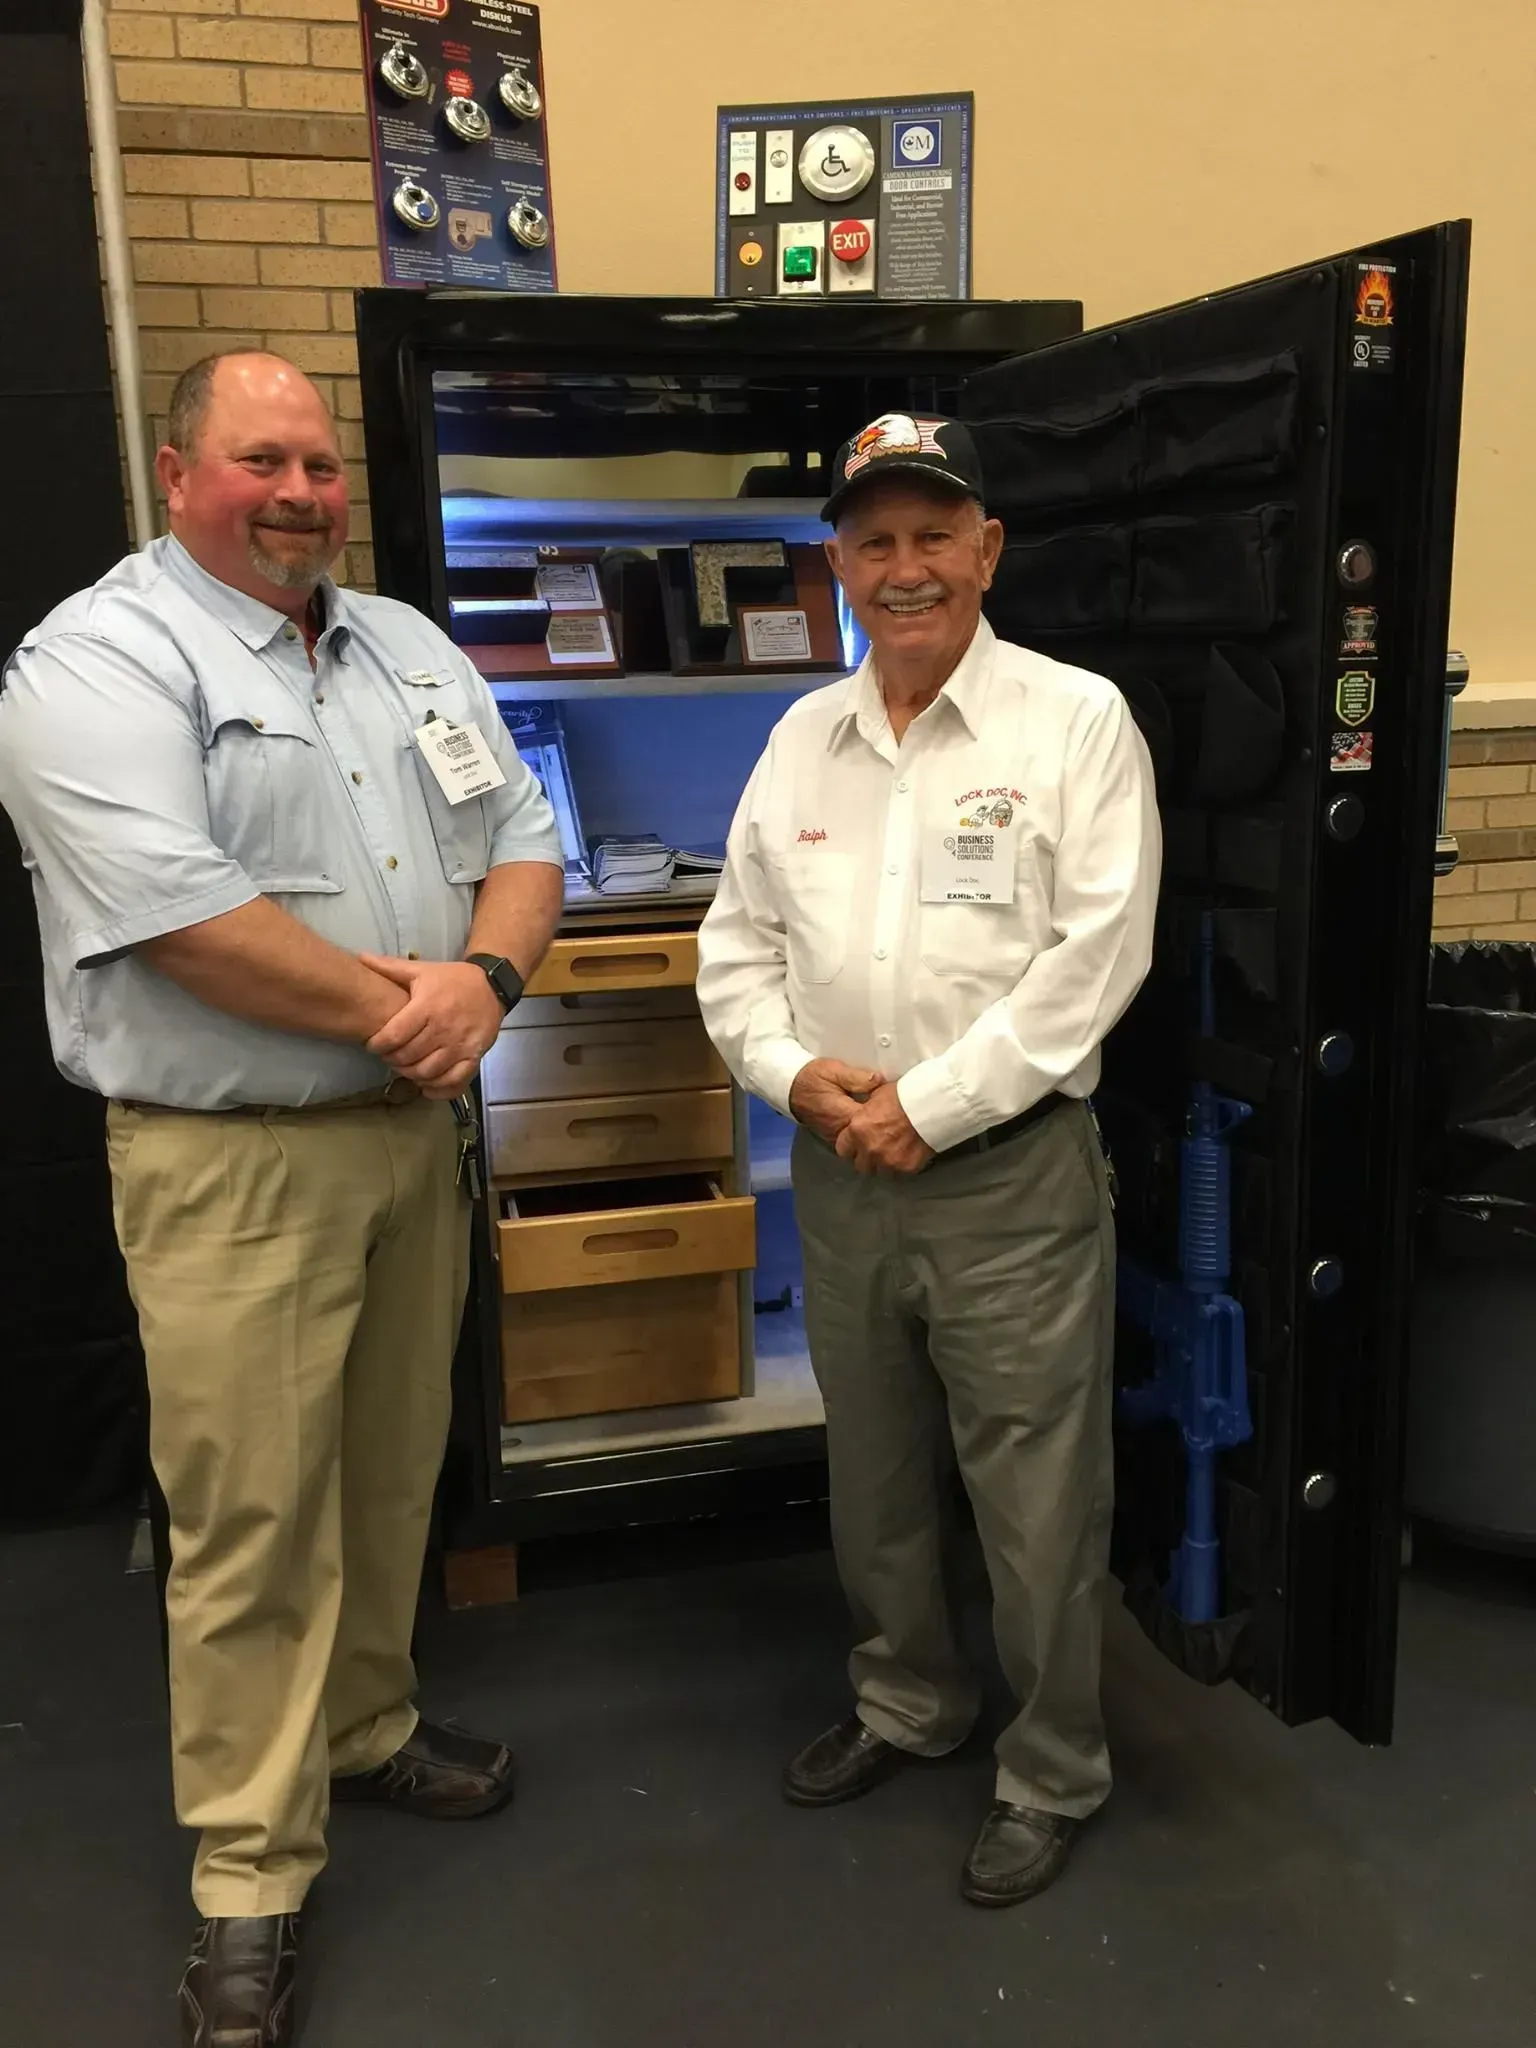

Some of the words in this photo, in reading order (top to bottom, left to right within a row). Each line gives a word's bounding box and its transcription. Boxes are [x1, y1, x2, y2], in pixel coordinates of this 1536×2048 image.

[480, 8, 513, 24] DISKUS
[889, 180, 908, 190] DOOR
[910, 178, 945, 190] CONTROLS
[833, 231, 867, 251] EXIT
[1343, 641, 1376, 650] APPROVED
[443, 731, 469, 746] BUSINESS
[447, 740, 473, 754] SOLUTIONS
[449, 766, 463, 774] Tom
[463, 780, 493, 796] EXHIBITOR
[954, 789, 984, 807] LOCK
[797, 828, 827, 845] Ralph
[957, 835, 994, 845] BUSINESS
[957, 845, 994, 854] SOLUTIONS
